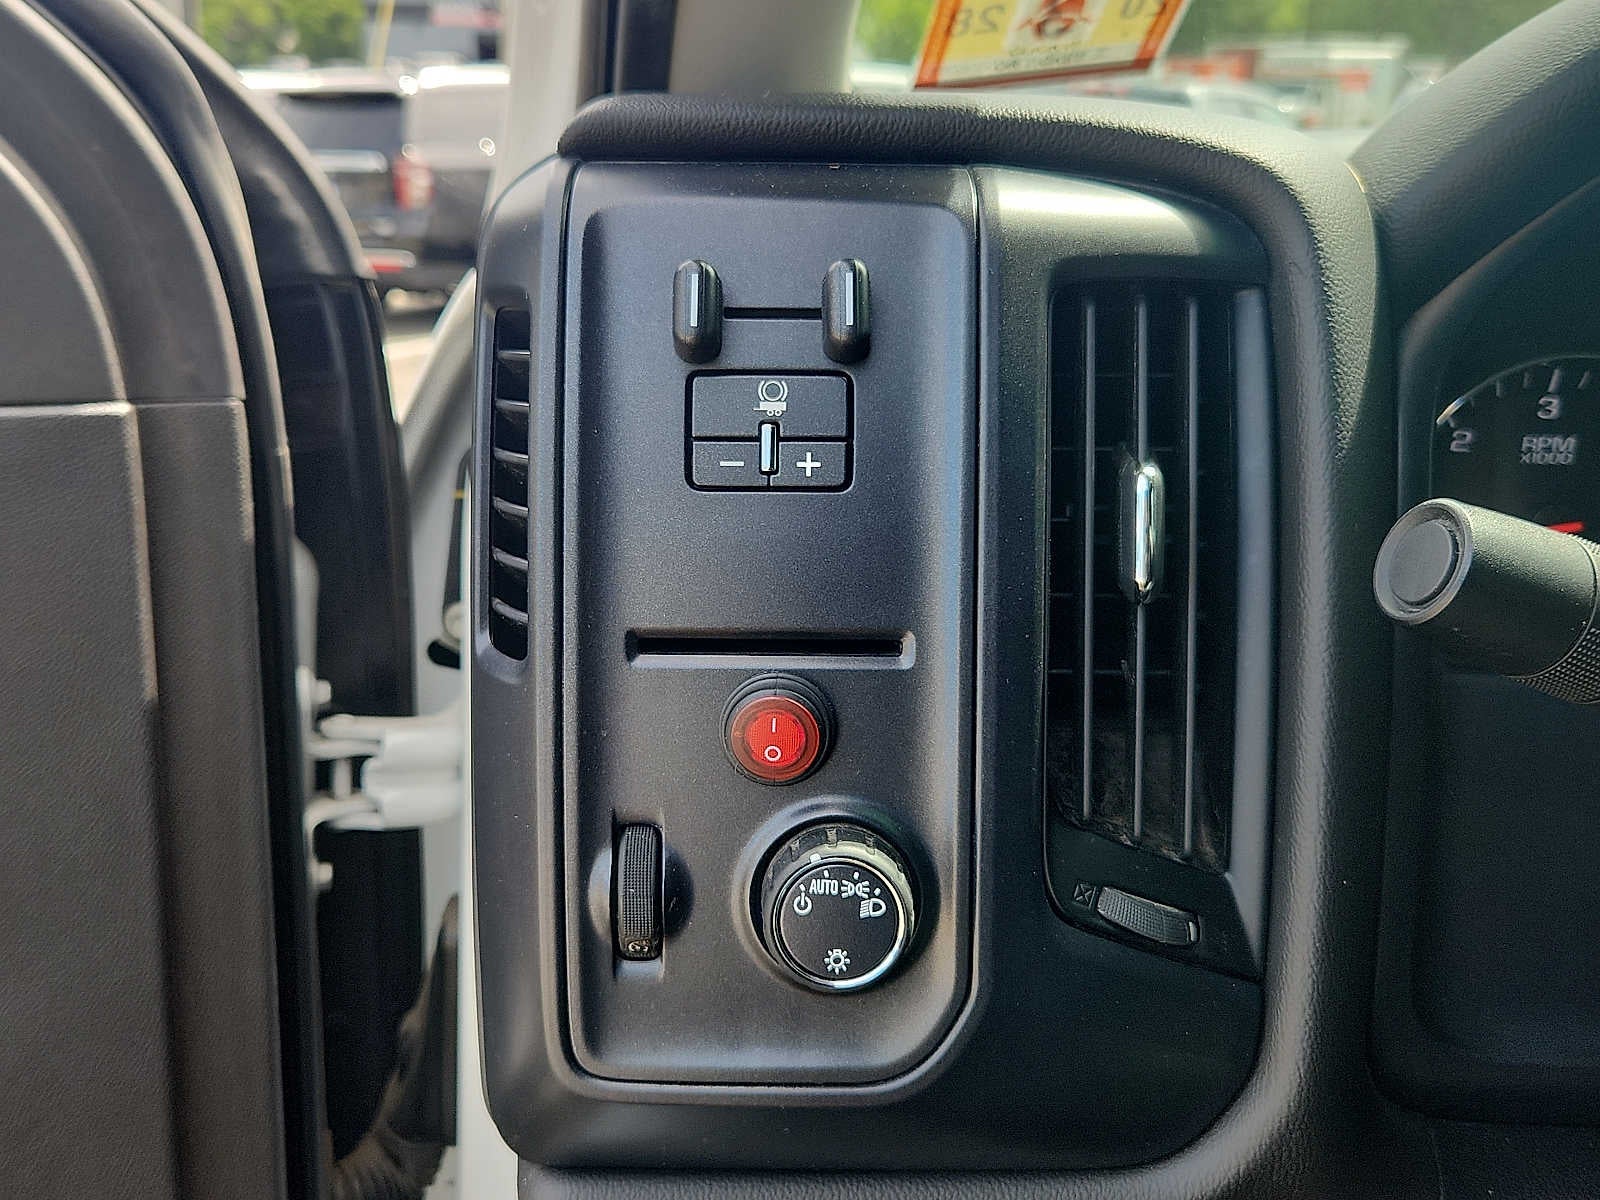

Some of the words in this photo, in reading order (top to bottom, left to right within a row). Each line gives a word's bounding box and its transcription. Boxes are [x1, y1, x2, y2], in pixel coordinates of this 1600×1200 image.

[1537, 395, 1561, 420] 3
[1450, 430, 1473, 453] 2
[1521, 435, 1577, 453] RPM
[809, 879, 839, 896] AUTO
